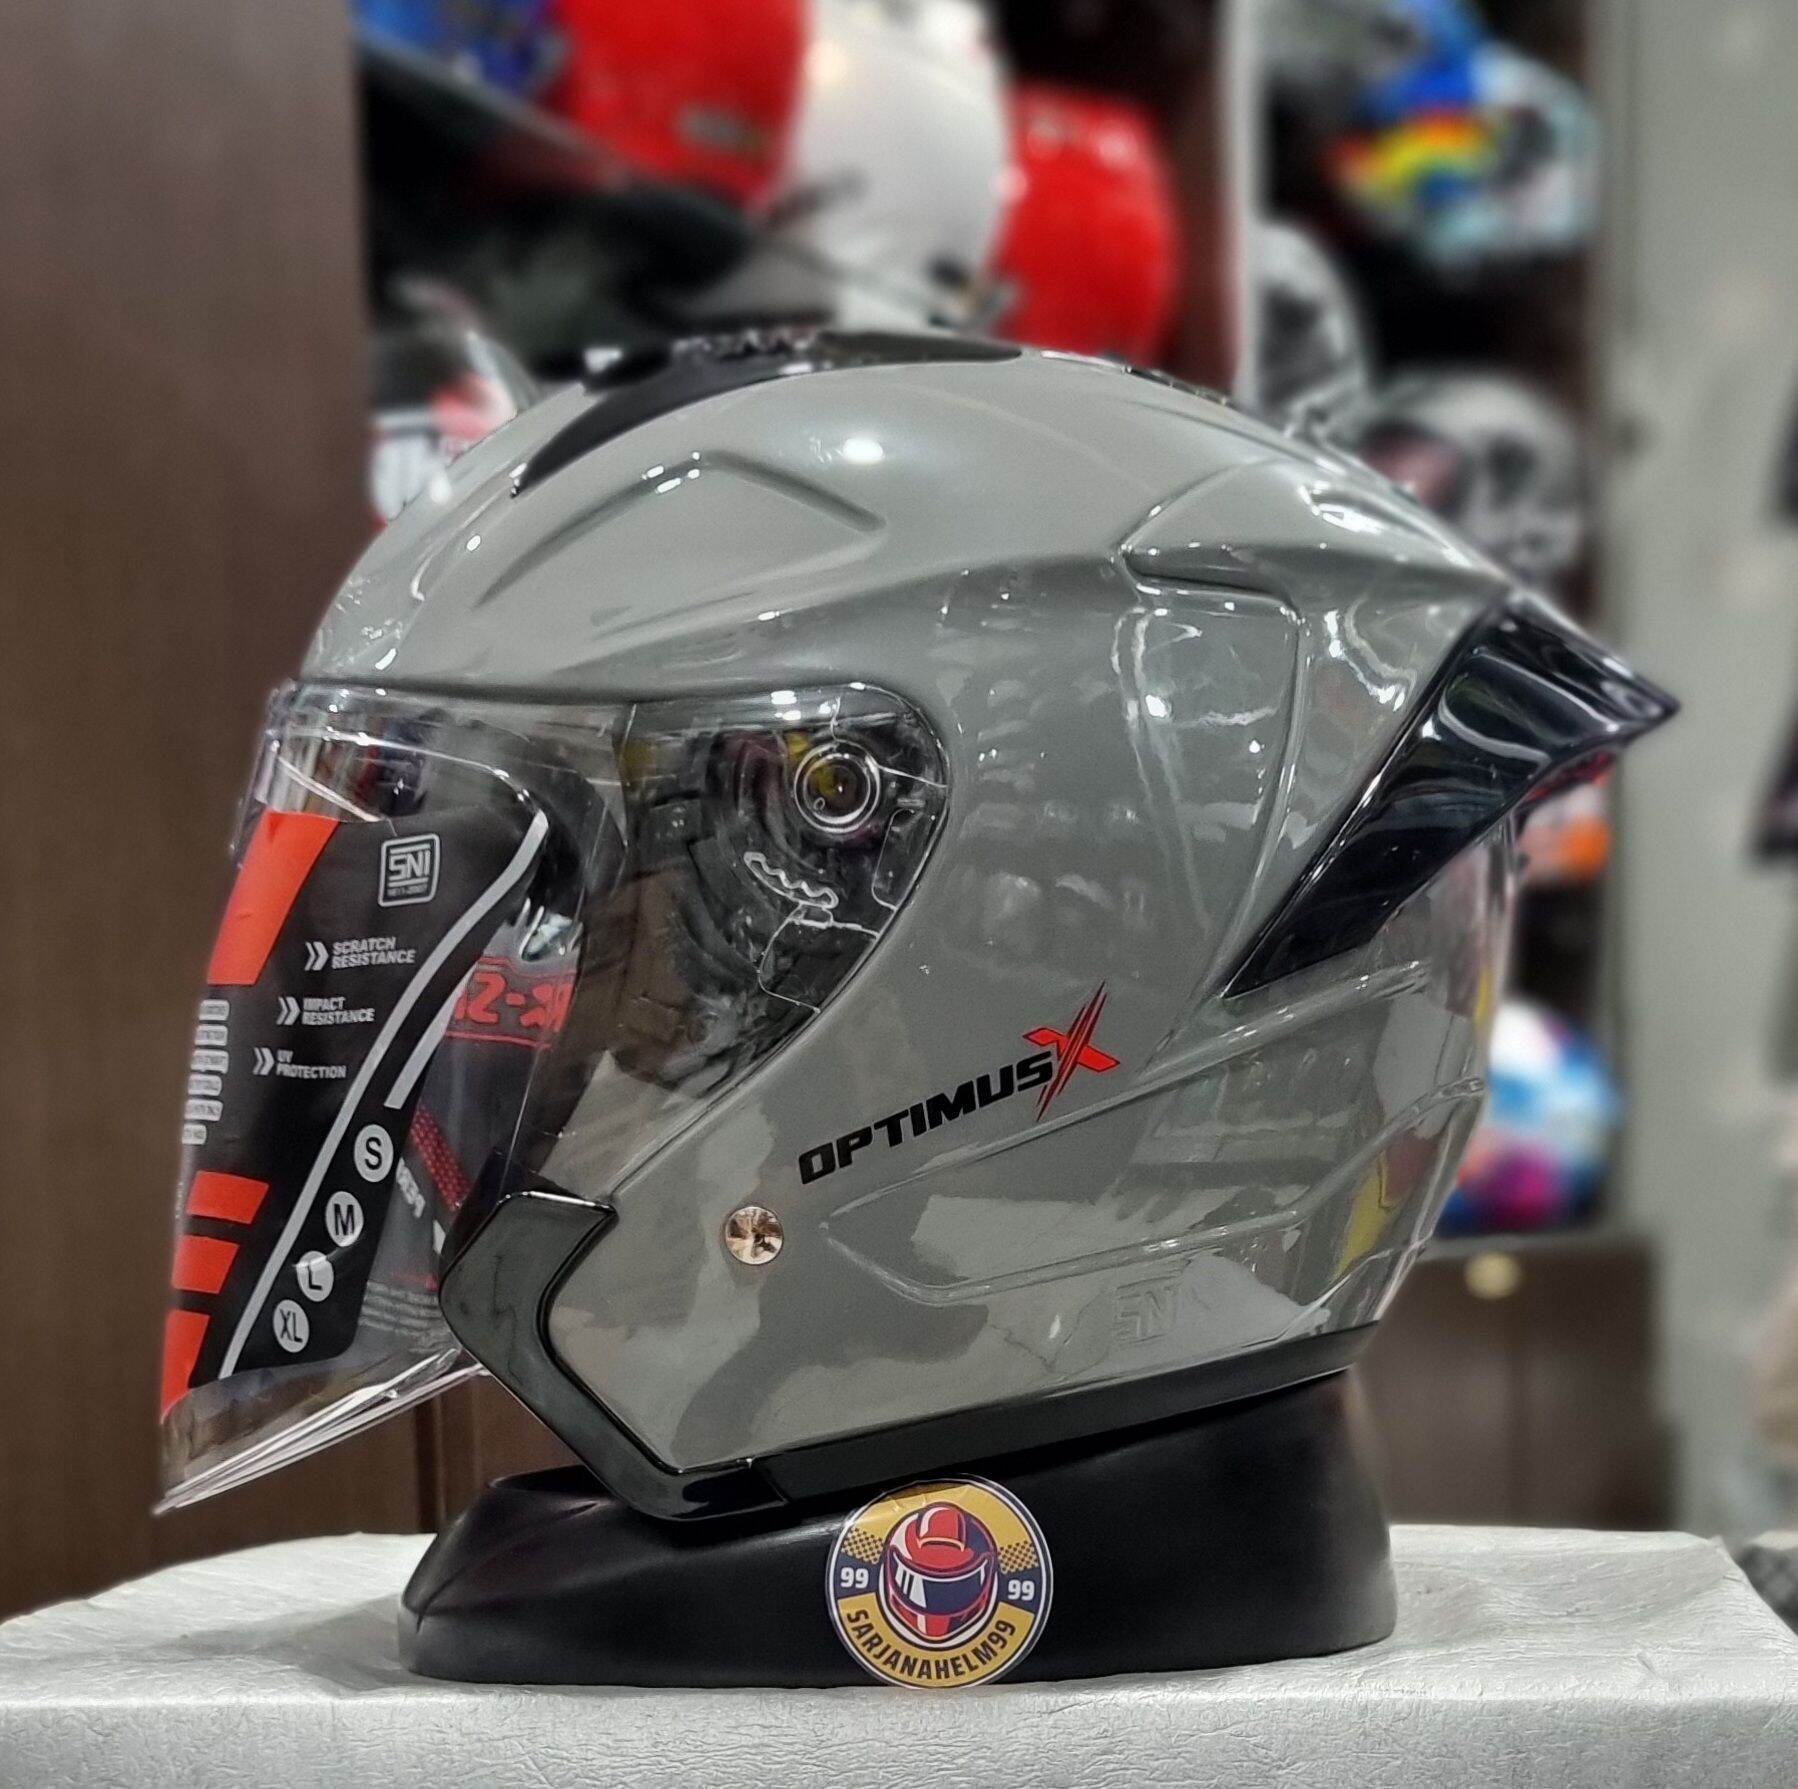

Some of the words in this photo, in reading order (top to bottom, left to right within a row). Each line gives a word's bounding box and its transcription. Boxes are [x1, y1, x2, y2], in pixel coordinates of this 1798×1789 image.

[389, 850, 431, 881] SNI
[332, 937, 397, 955] SCRATCH
[331, 950, 416, 969] RESISTANCE
[302, 1008, 376, 1026] RESISTANCE
[303, 996, 346, 1013] IMPACT
[276, 1062, 347, 1079] PROTECTION
[798, 1050, 1054, 1185] OPTIMUS
[364, 1136, 383, 1170] S
[335, 1203, 355, 1237] M
[306, 1263, 323, 1291] L
[279, 1310, 303, 1343] XL
[840, 1567, 869, 1589] 99
[1007, 1579, 1035, 1601] 99
[846, 1609, 1016, 1680] SARJANAHELM99
